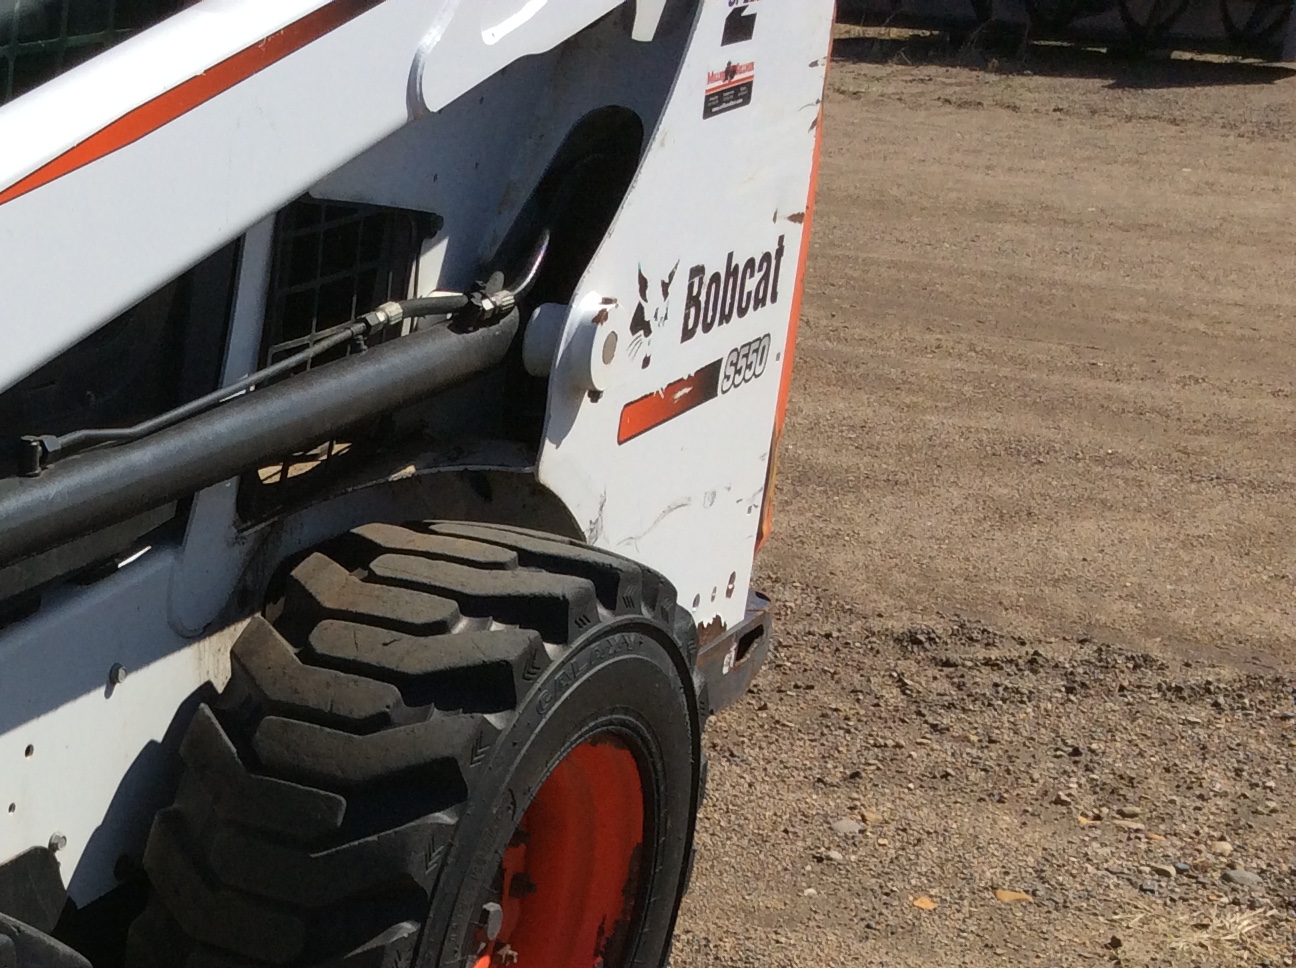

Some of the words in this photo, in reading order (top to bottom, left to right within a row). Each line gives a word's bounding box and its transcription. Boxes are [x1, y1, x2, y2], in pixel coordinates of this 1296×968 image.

[680, 234, 785, 344] Bobcat
[721, 333, 771, 394] S550
[535, 632, 636, 716] GALAXY
